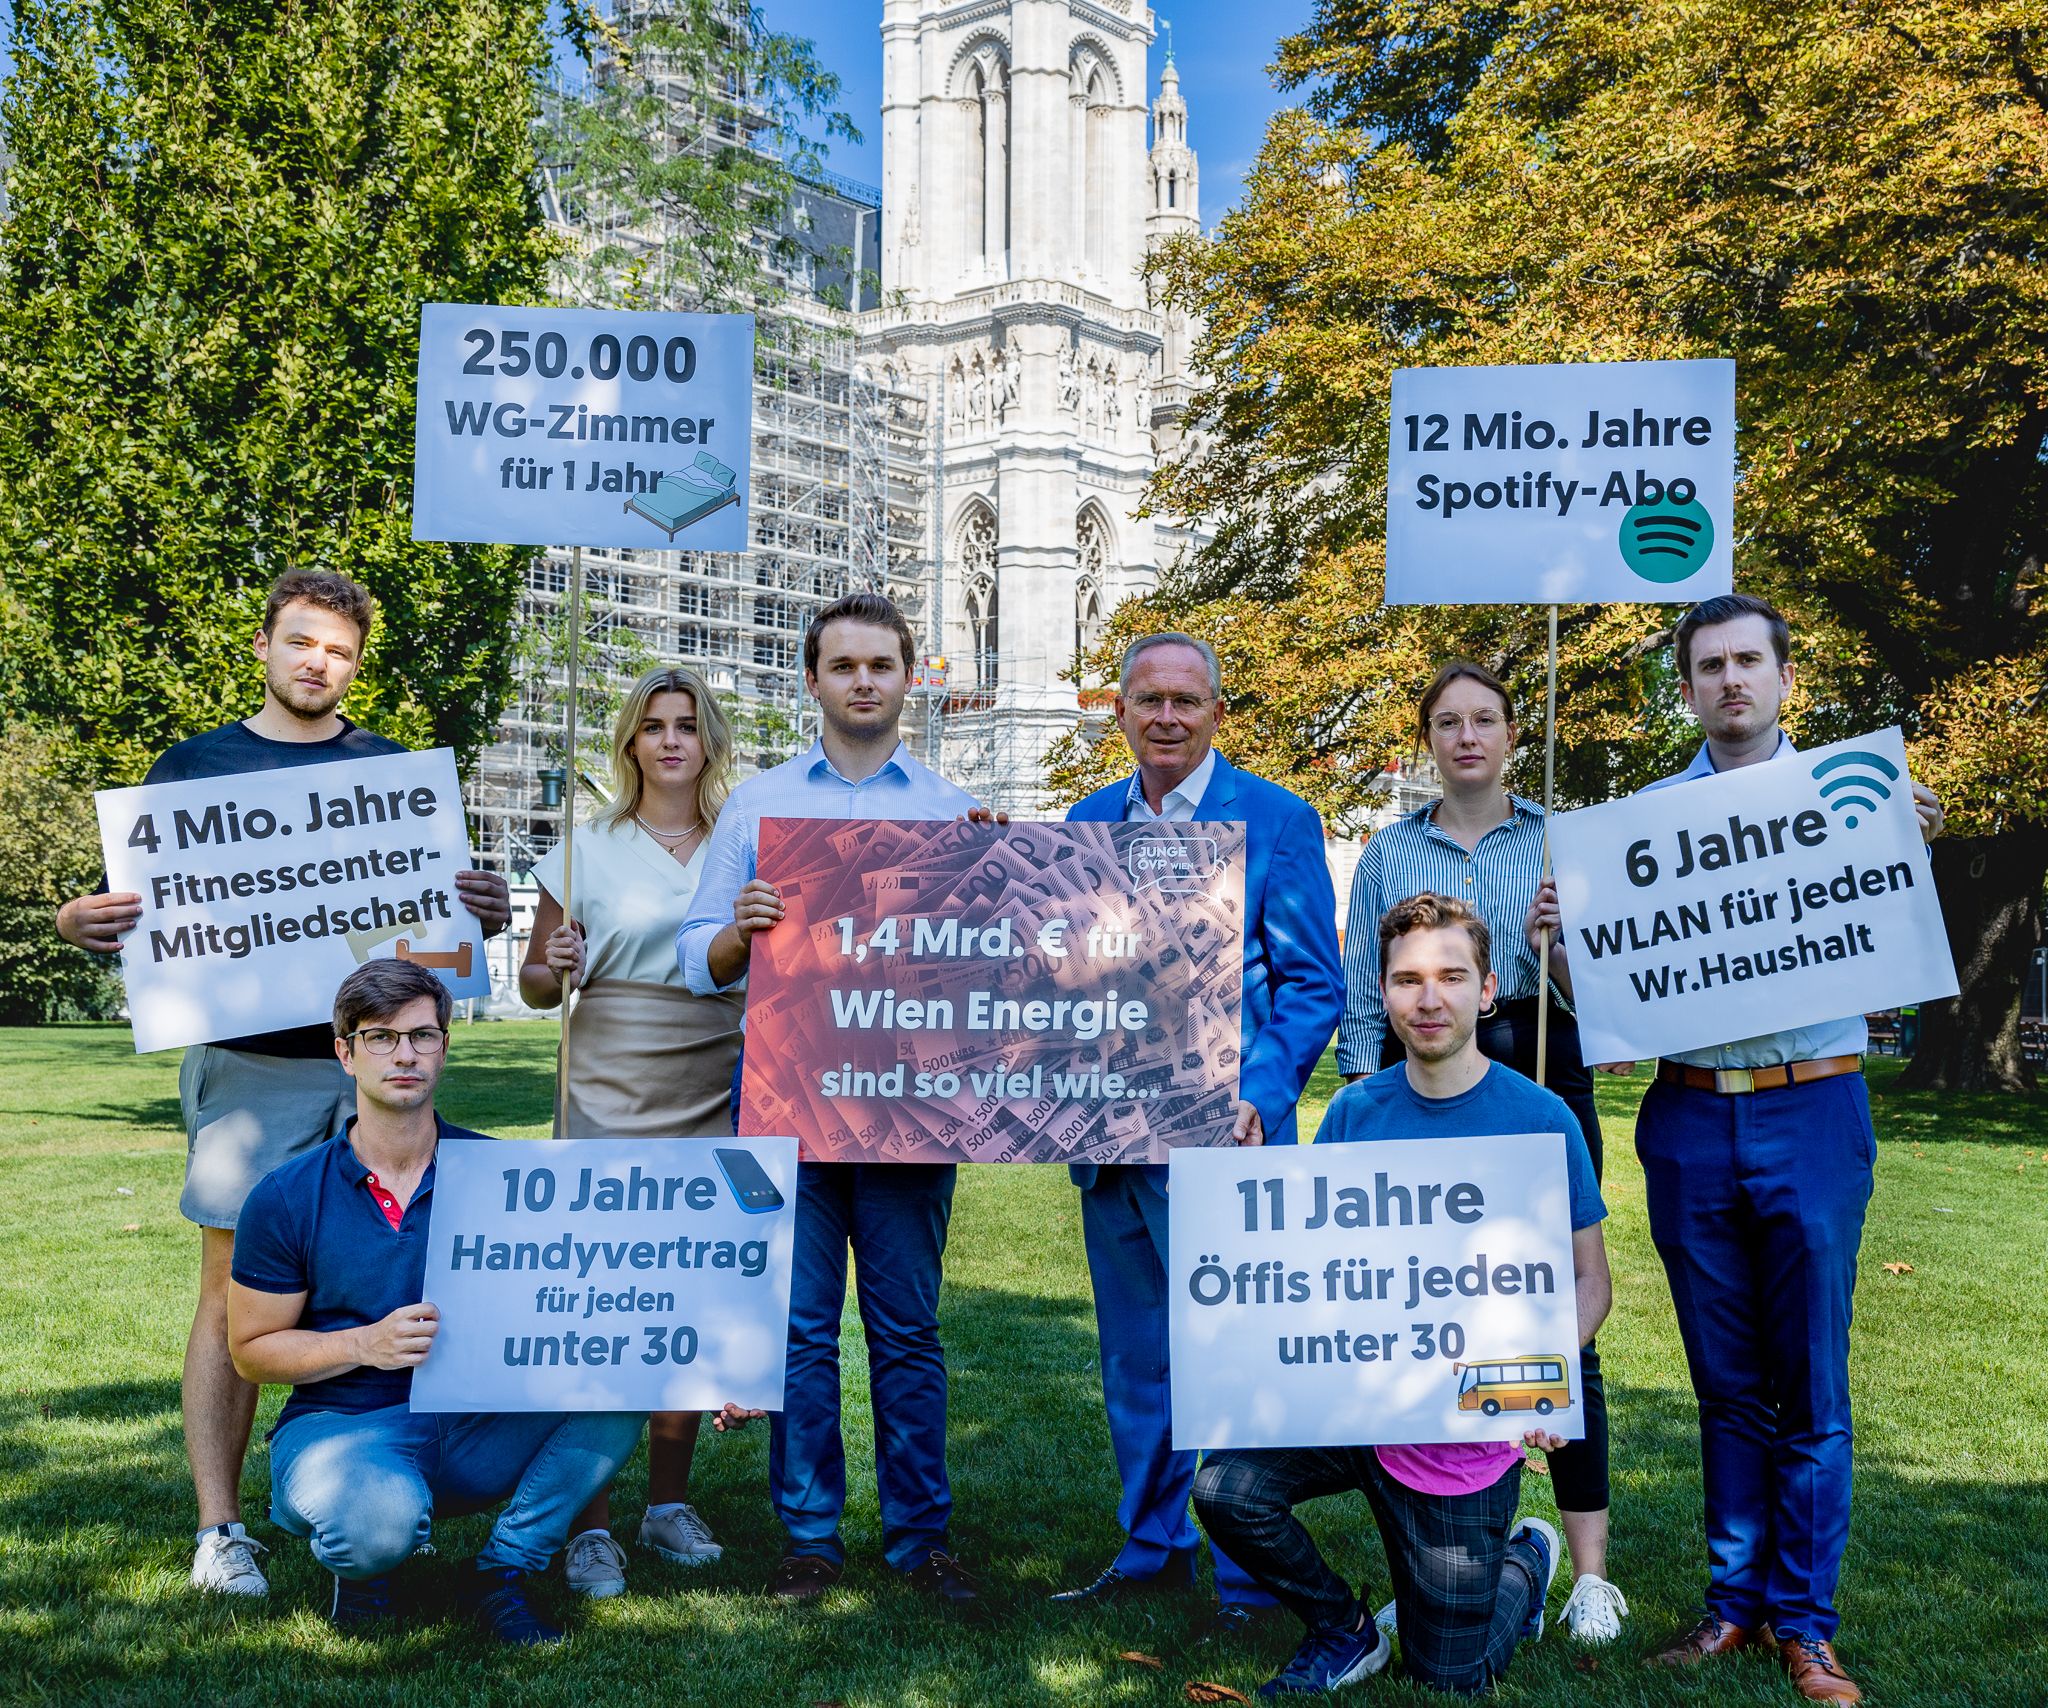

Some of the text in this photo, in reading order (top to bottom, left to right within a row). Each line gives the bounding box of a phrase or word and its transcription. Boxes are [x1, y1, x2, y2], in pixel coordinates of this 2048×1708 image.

[463, 328, 697, 384] 250.000
[445, 400, 715, 445] WG-Zimmer
[1404, 408, 1712, 452] 12 Mio. Jahre
[500, 457, 664, 494] für 1 Jahr
[1416, 469, 1697, 519] Spotify-Abo
[128, 785, 437, 854] 4 Mio. Jahre
[1138, 846, 1188, 857] JUNGE
[1138, 858, 1168, 870] ÖVP
[1625, 808, 1828, 888] 6 Jahre
[151, 846, 441, 910] Fitnesscenter-
[150, 887, 451, 963] Mitgliedschaft
[1580, 860, 1915, 961] WLAN für jeden
[837, 917, 1142, 964] 1,4 Mrd. € für
[1629, 922, 1876, 1003] Wr.Haushalt
[830, 989, 1148, 1040] Wien Energie
[820, 1063, 1160, 1099] sind so viel wie...
[922, 1054, 949, 1073] 500
[974, 1094, 999, 1122] 500
[1026, 1100, 1051, 1127] 500
[966, 1127, 992, 1152] 500
[1058, 1120, 1084, 1147] 500
[502, 1166, 717, 1213] 10 Jahre
[1236, 1172, 1485, 1232] 11 Jahre
[450, 1233, 769, 1279] Handyvertrag
[536, 1286, 675, 1319] für jeden
[1188, 1253, 1555, 1310] Öffis für jeden
[503, 1326, 699, 1367] unter 30
[1278, 1322, 1466, 1365] unter 30
